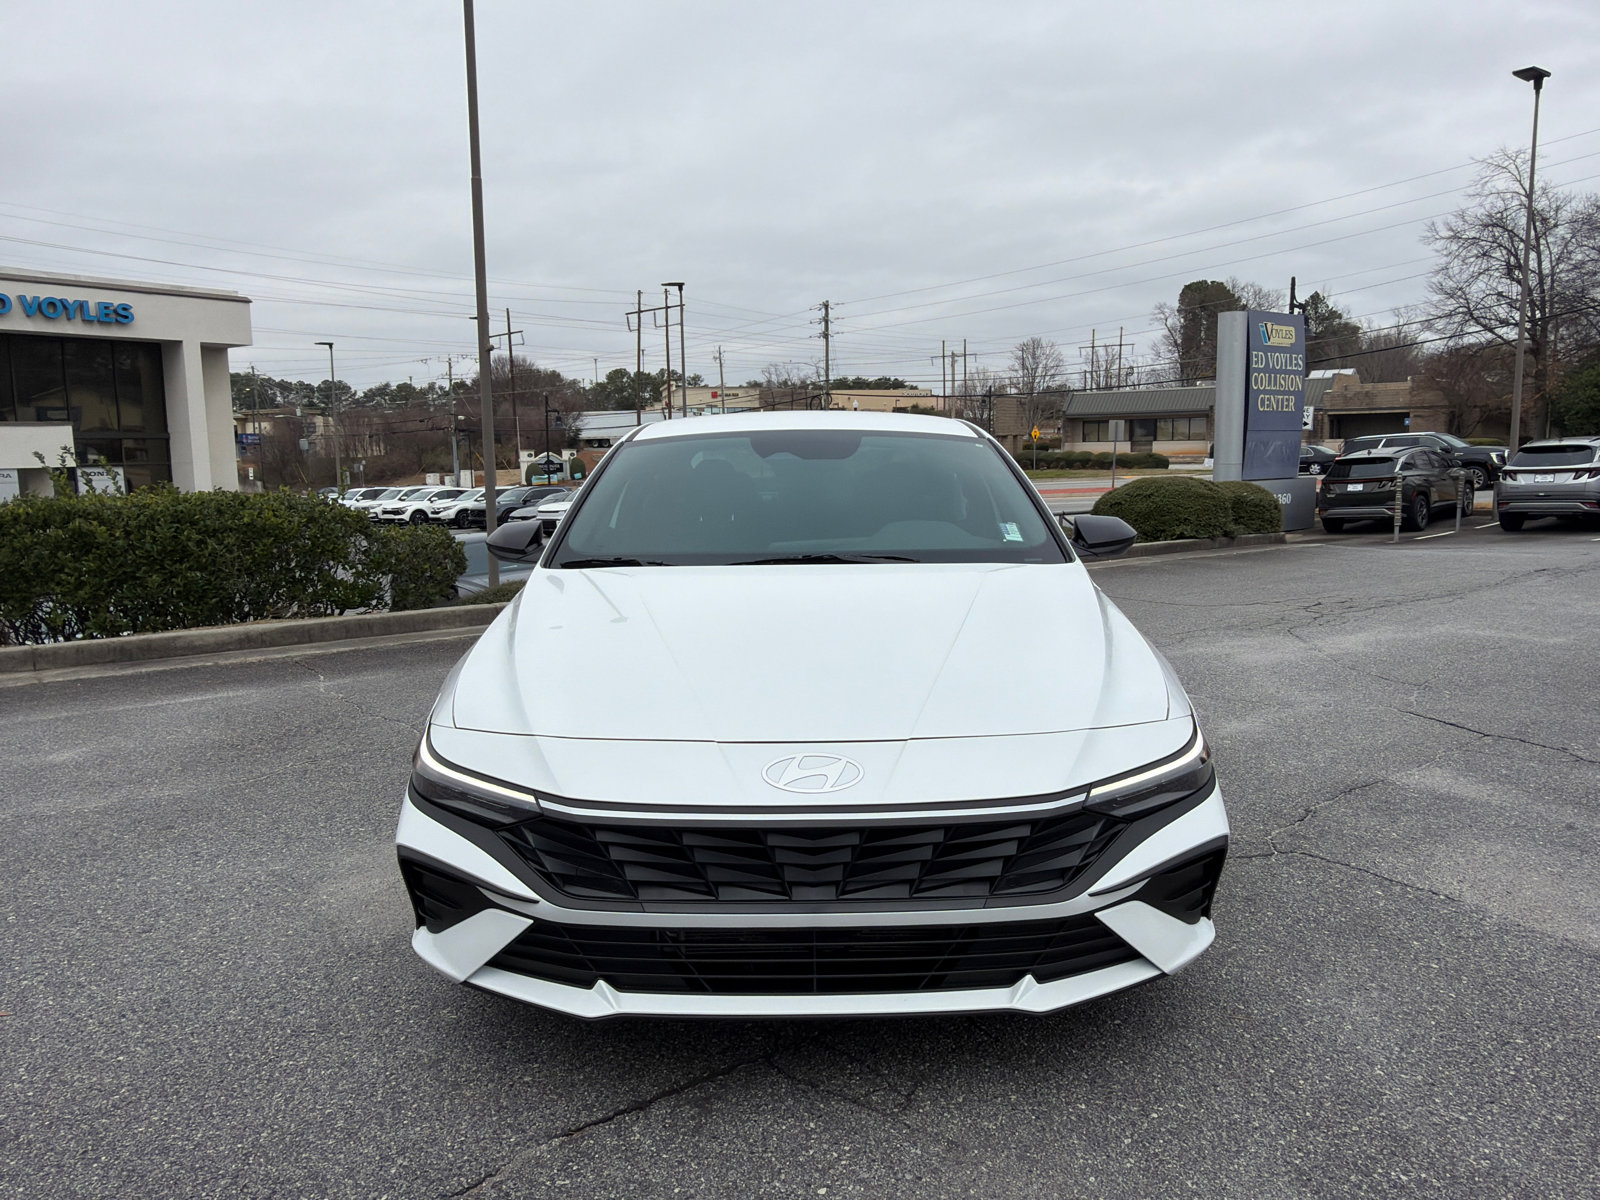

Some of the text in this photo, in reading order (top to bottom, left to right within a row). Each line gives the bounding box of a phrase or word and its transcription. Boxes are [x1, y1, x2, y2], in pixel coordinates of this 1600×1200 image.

[18, 294, 135, 325] VOYLES
[1263, 322, 1294, 342] VOYLES
[1252, 351, 1303, 371] ED VOYLES
[1252, 372, 1303, 391] COLLISION
[1258, 394, 1296, 412] CENTER
